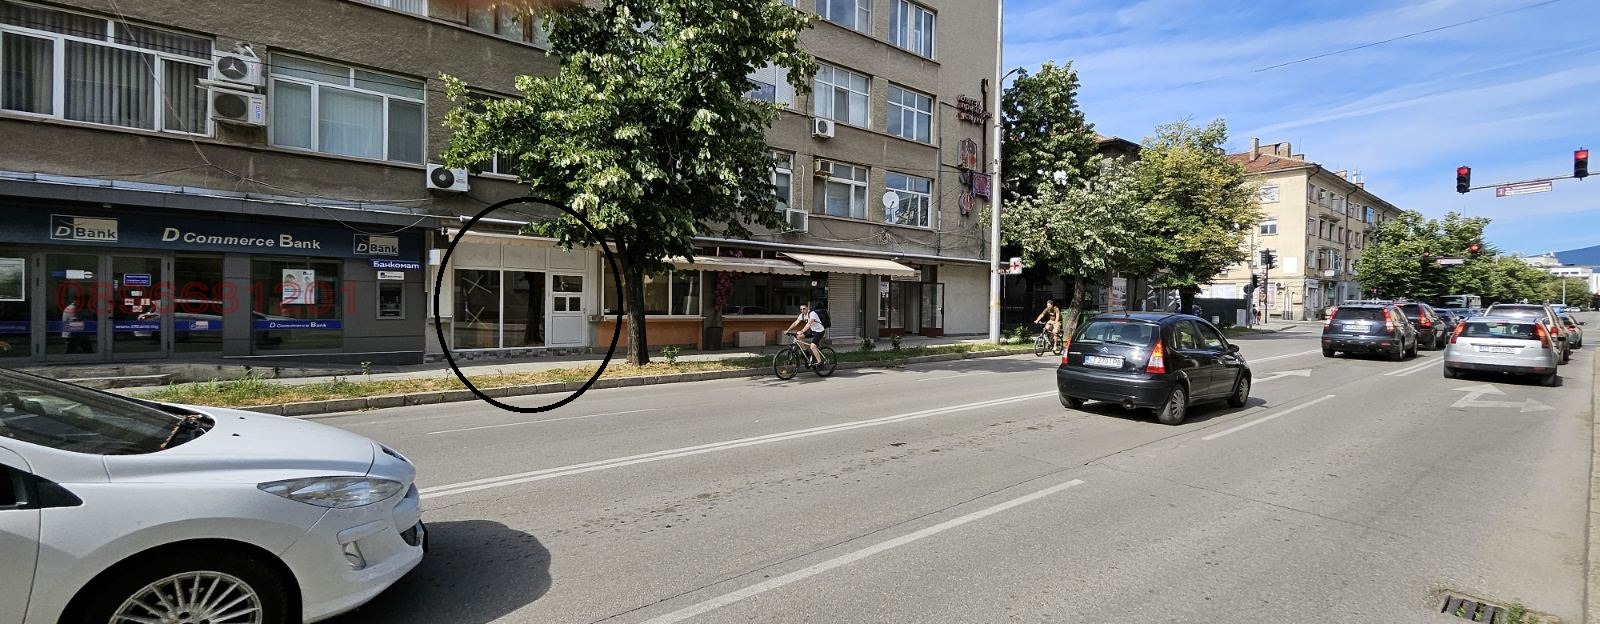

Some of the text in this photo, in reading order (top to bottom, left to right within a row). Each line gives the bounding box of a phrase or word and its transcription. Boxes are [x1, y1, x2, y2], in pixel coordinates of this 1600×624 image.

[75, 227, 117, 239] Bank
[162, 227, 321, 250] D Commerce Bank
[370, 243, 399, 254] Bank
[373, 260, 420, 270] Банкомат
